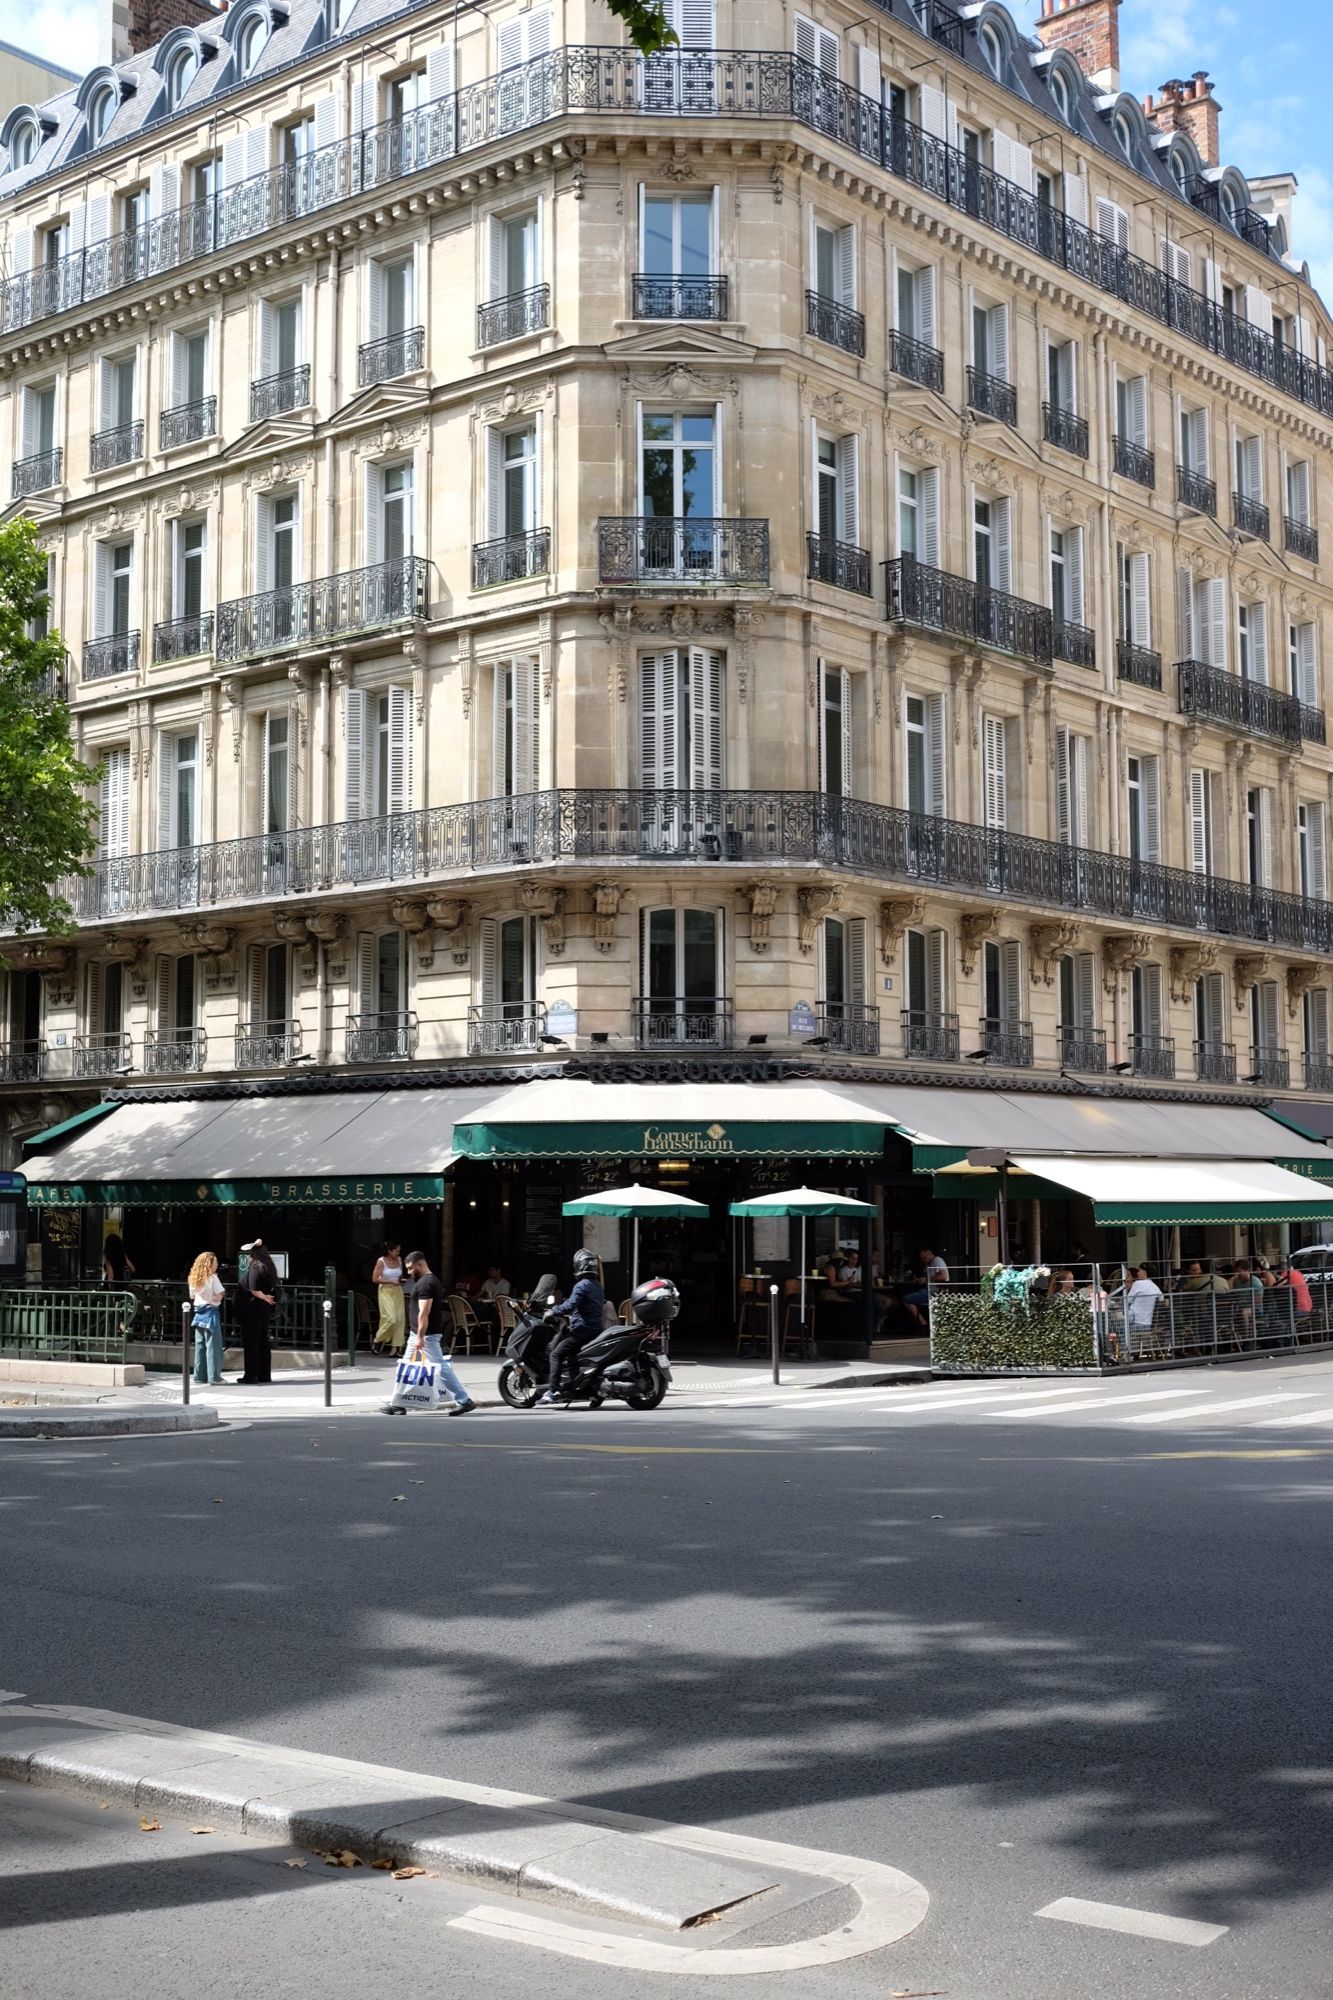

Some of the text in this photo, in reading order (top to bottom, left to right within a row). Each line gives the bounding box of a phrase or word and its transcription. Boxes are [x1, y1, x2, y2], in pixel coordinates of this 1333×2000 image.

[588, 1062, 785, 1080] RESTAURANT
[644, 1126, 702, 1141] Corner
[1276, 1163, 1313, 1174] ERIE
[27, 1188, 70, 1199] AFE
[271, 1182, 414, 1197] BRASSERIE
[396, 1363, 435, 1387] ION
[402, 1394, 430, 1402] ACTION
